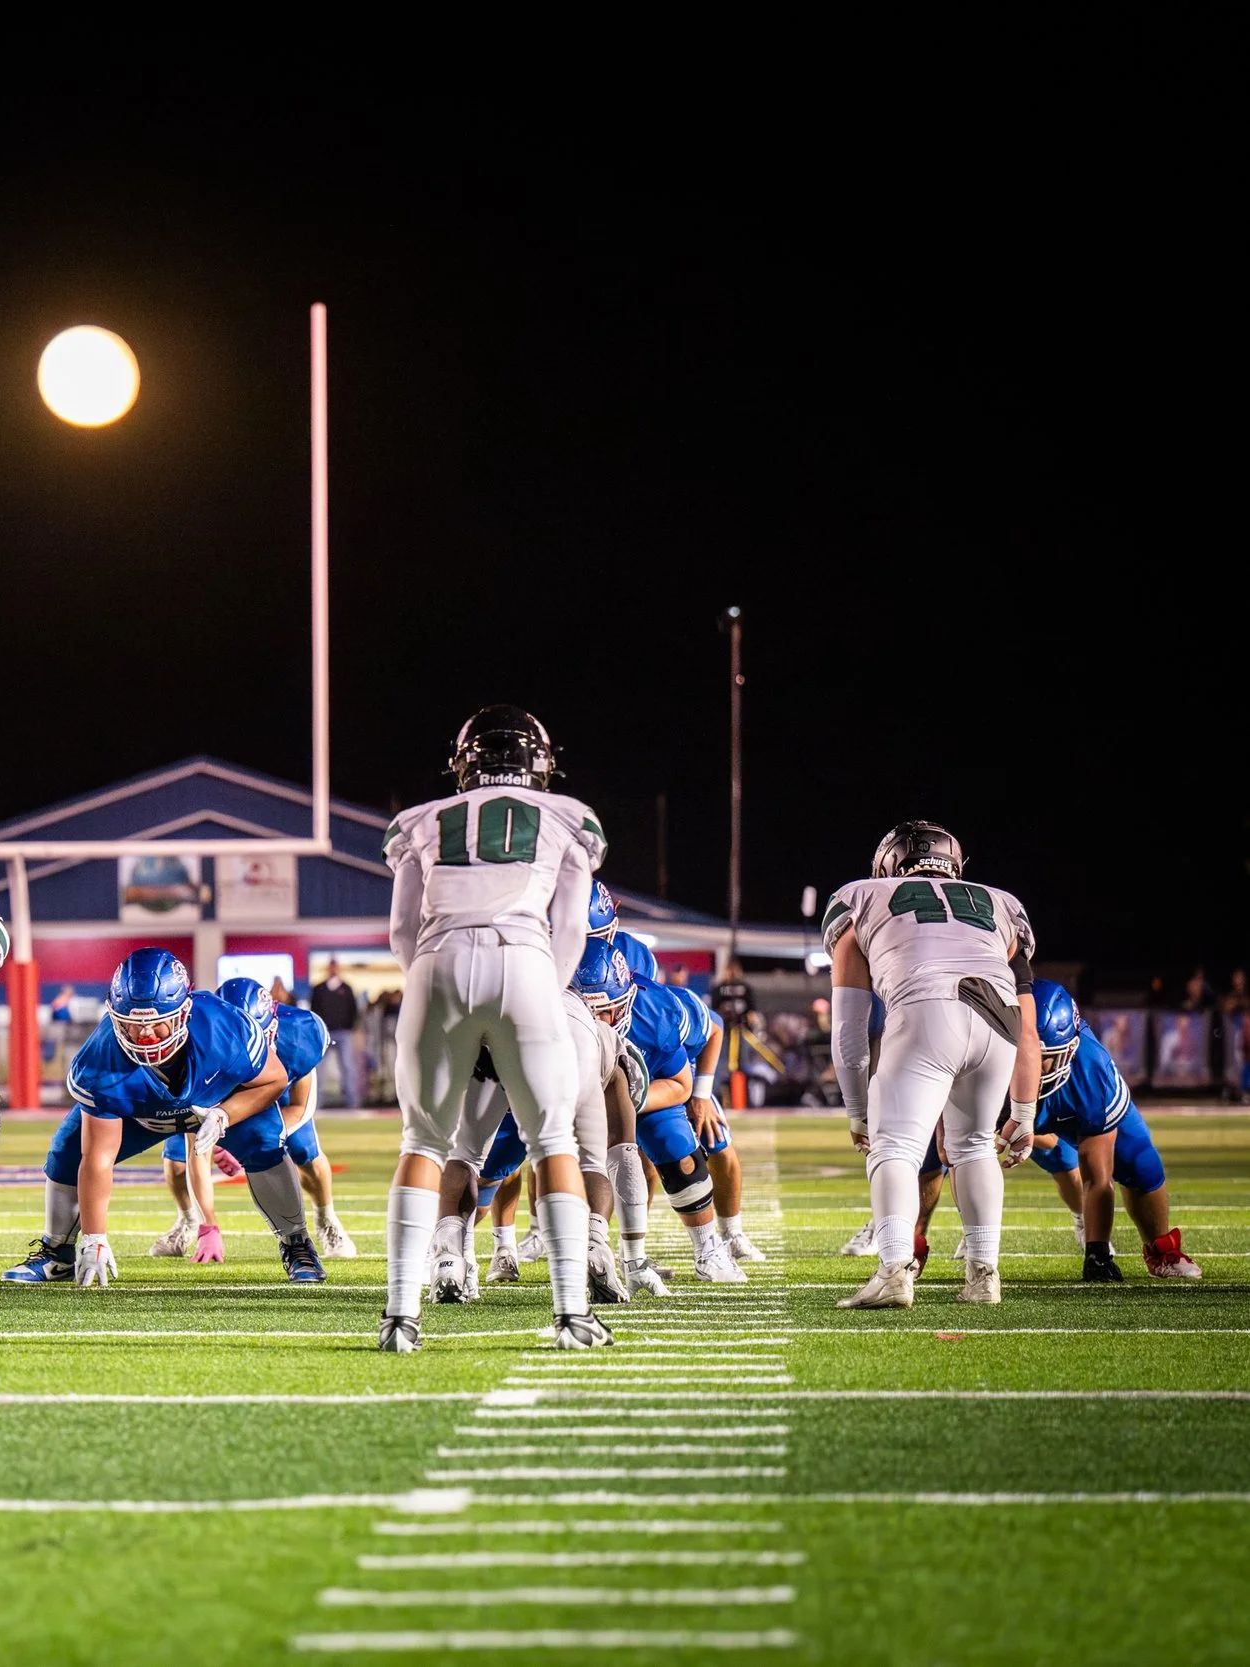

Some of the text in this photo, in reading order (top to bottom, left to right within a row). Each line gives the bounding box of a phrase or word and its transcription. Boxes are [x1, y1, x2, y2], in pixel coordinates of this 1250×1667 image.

[479, 772, 531, 787] Riddell
[432, 796, 541, 865] 10
[888, 881, 996, 932] 40
